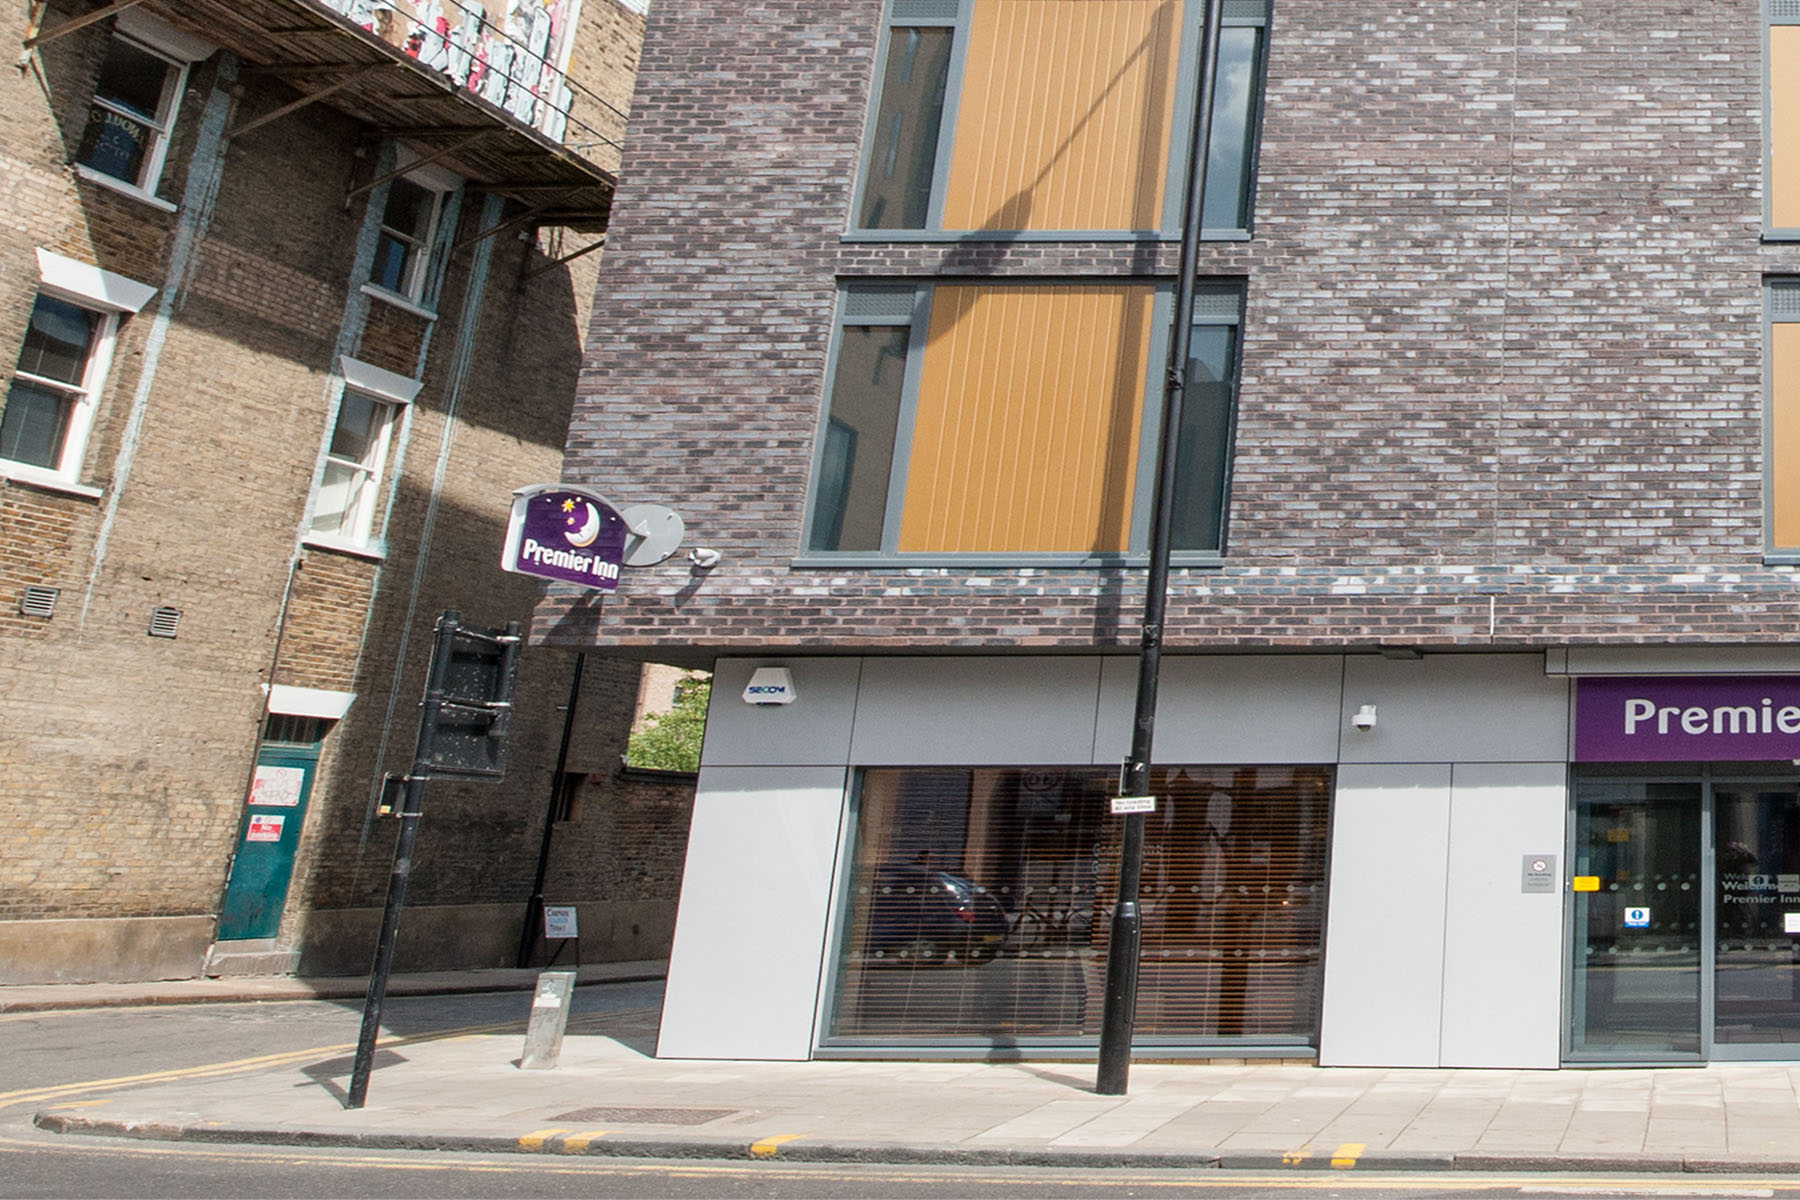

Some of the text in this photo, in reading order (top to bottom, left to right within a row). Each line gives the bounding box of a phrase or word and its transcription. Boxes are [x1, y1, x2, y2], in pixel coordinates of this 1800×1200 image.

[522, 538, 619, 580] Premier Inn
[1723, 894, 1800, 904] Premier Inn
